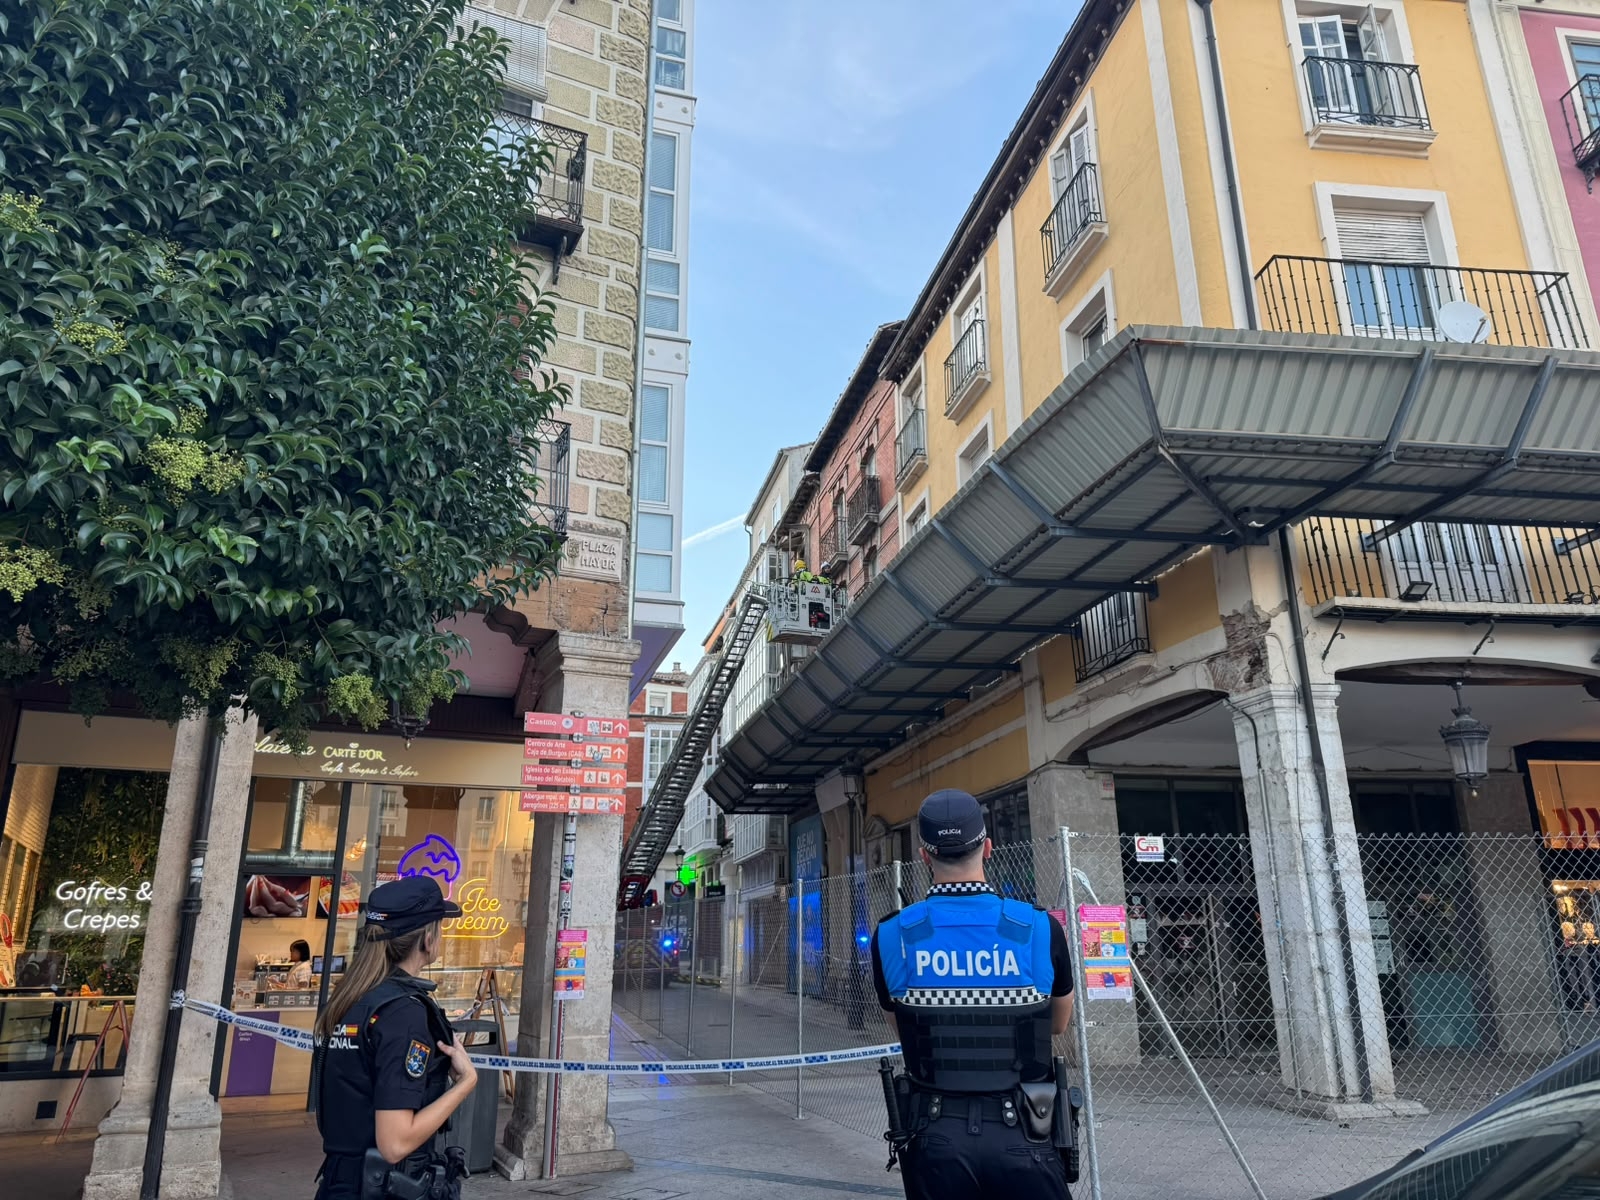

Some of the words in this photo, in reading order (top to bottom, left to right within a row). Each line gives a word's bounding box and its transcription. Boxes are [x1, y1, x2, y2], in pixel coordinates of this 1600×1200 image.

[581, 540, 616, 555] PLAZA
[580, 556, 616, 570] MAYOR
[529, 718, 557, 727] Castillo
[323, 745, 359, 759] CARTE
[526, 748, 539, 756] Caja
[547, 750, 567, 759] Burgos
[525, 765, 543, 774] Iglesia
[524, 774, 544, 782] (Museo
[523, 792, 545, 801] Albergue
[523, 802, 548, 810] peregrinos
[56, 880, 128, 905] Gofres
[135, 881, 153, 901] &
[461, 887, 501, 913] Ice
[63, 908, 141, 934] Crepes
[441, 915, 510, 935] ream
[915, 943, 1021, 977] POLICÍA
